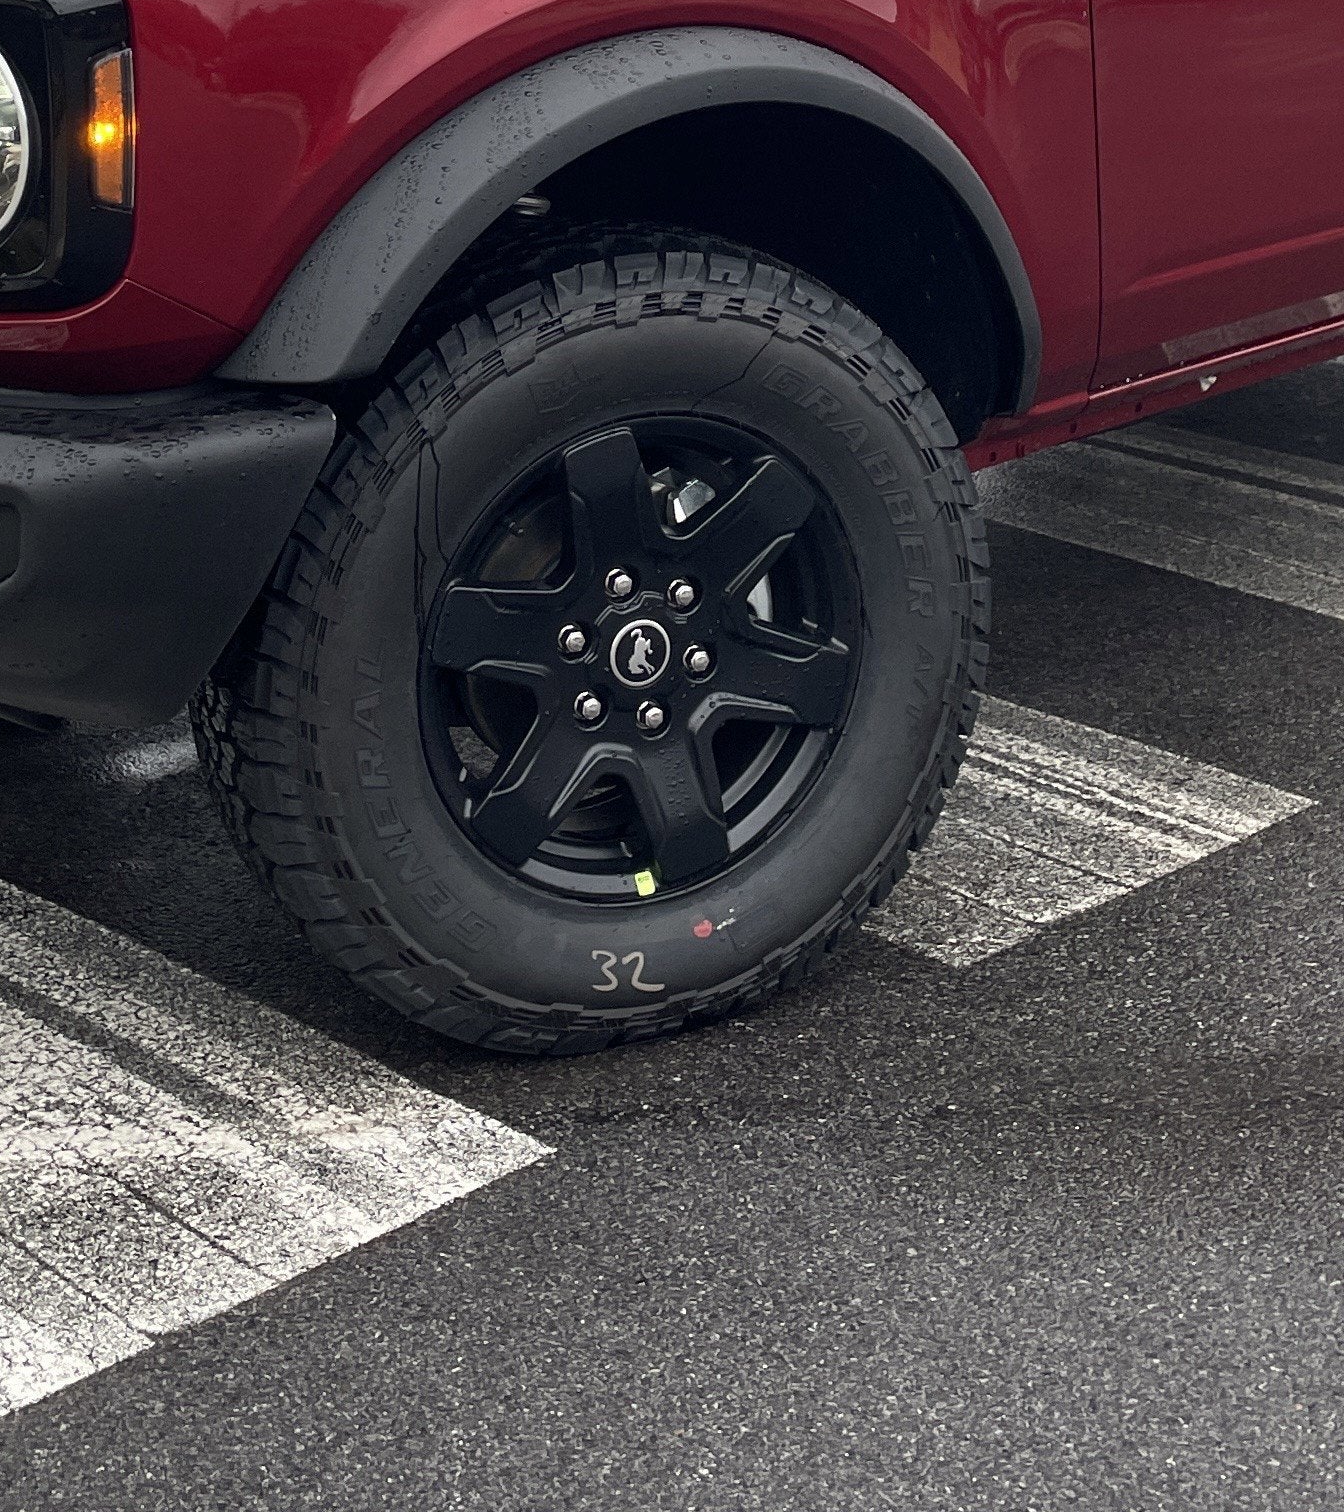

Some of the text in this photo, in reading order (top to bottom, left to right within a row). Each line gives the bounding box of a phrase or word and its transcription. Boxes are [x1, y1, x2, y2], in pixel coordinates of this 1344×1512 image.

[759, 361, 936, 618] GRABBER
[350, 656, 499, 953] GENERAL
[591, 949, 666, 992] 32
